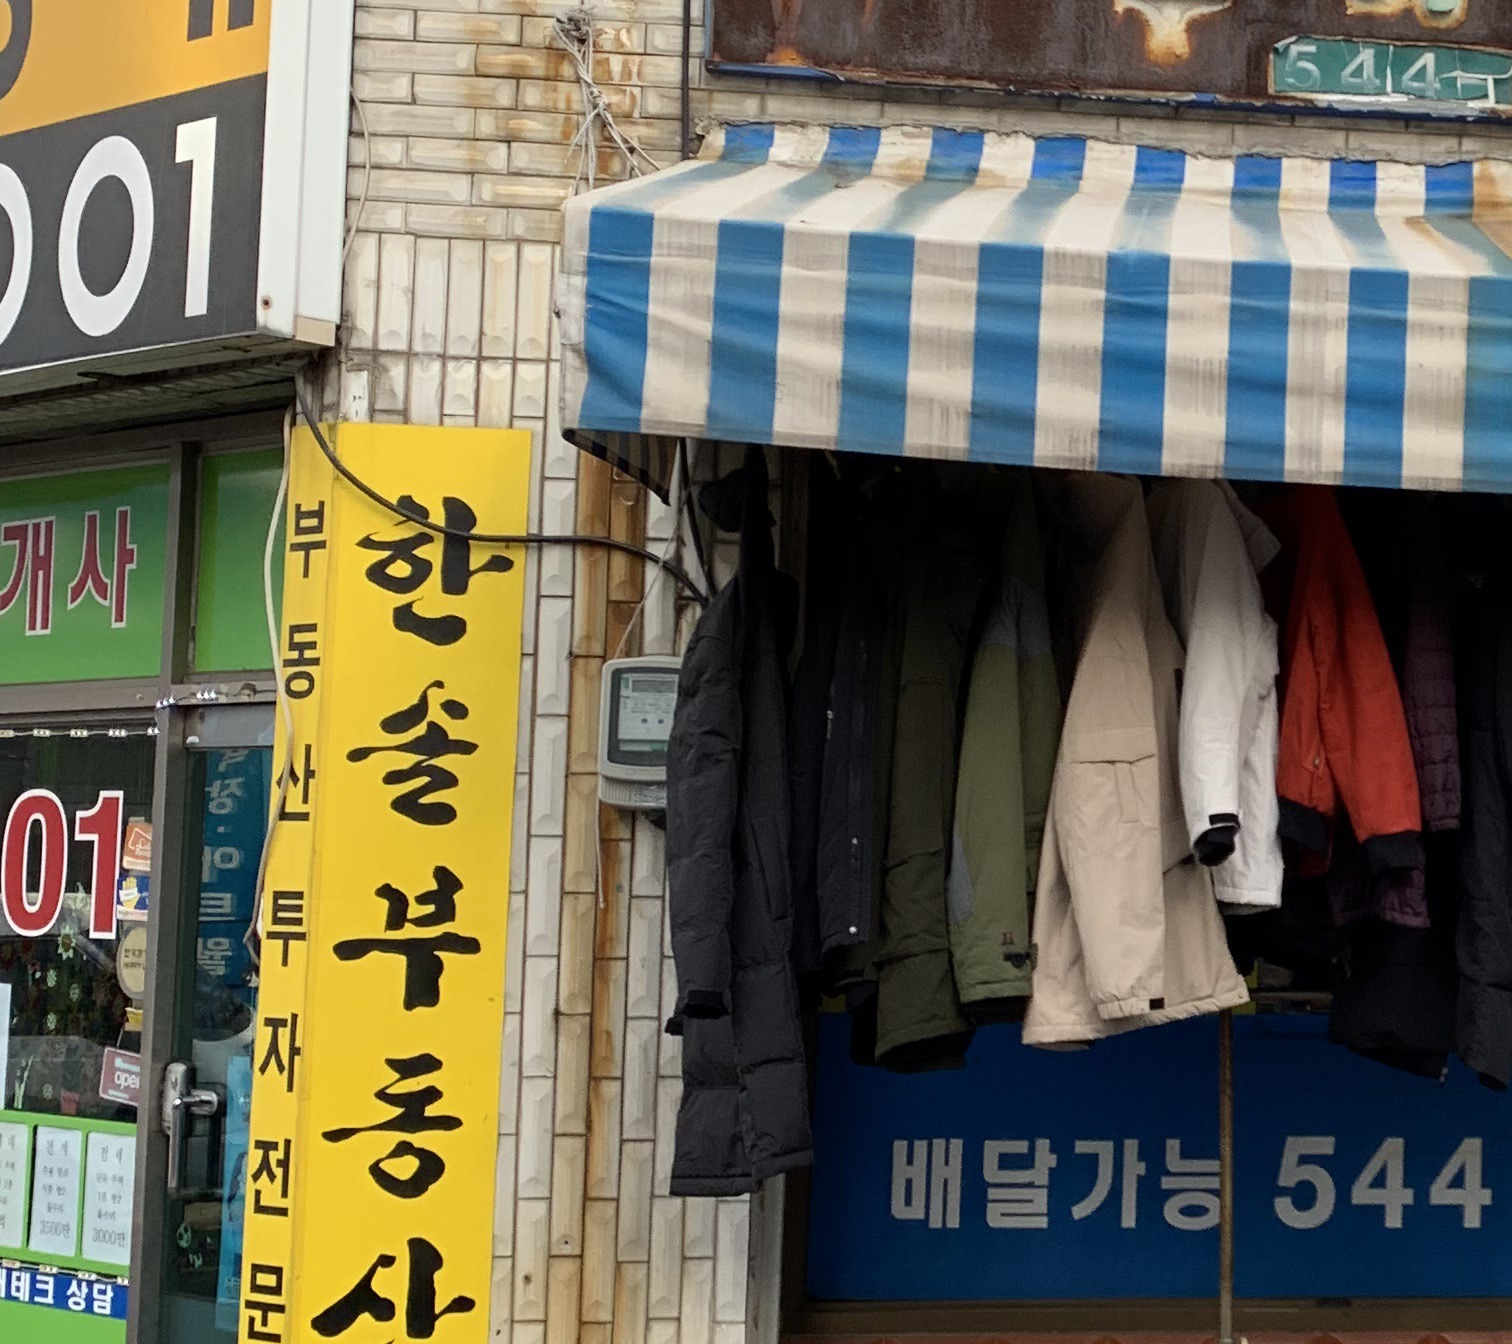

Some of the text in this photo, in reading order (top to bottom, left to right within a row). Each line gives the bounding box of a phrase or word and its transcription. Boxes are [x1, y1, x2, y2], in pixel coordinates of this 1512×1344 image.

[889, 1136, 1227, 1232] 배달가능
[1272, 1135, 1493, 1230] 544
[65, 1278, 115, 1317] 상담
